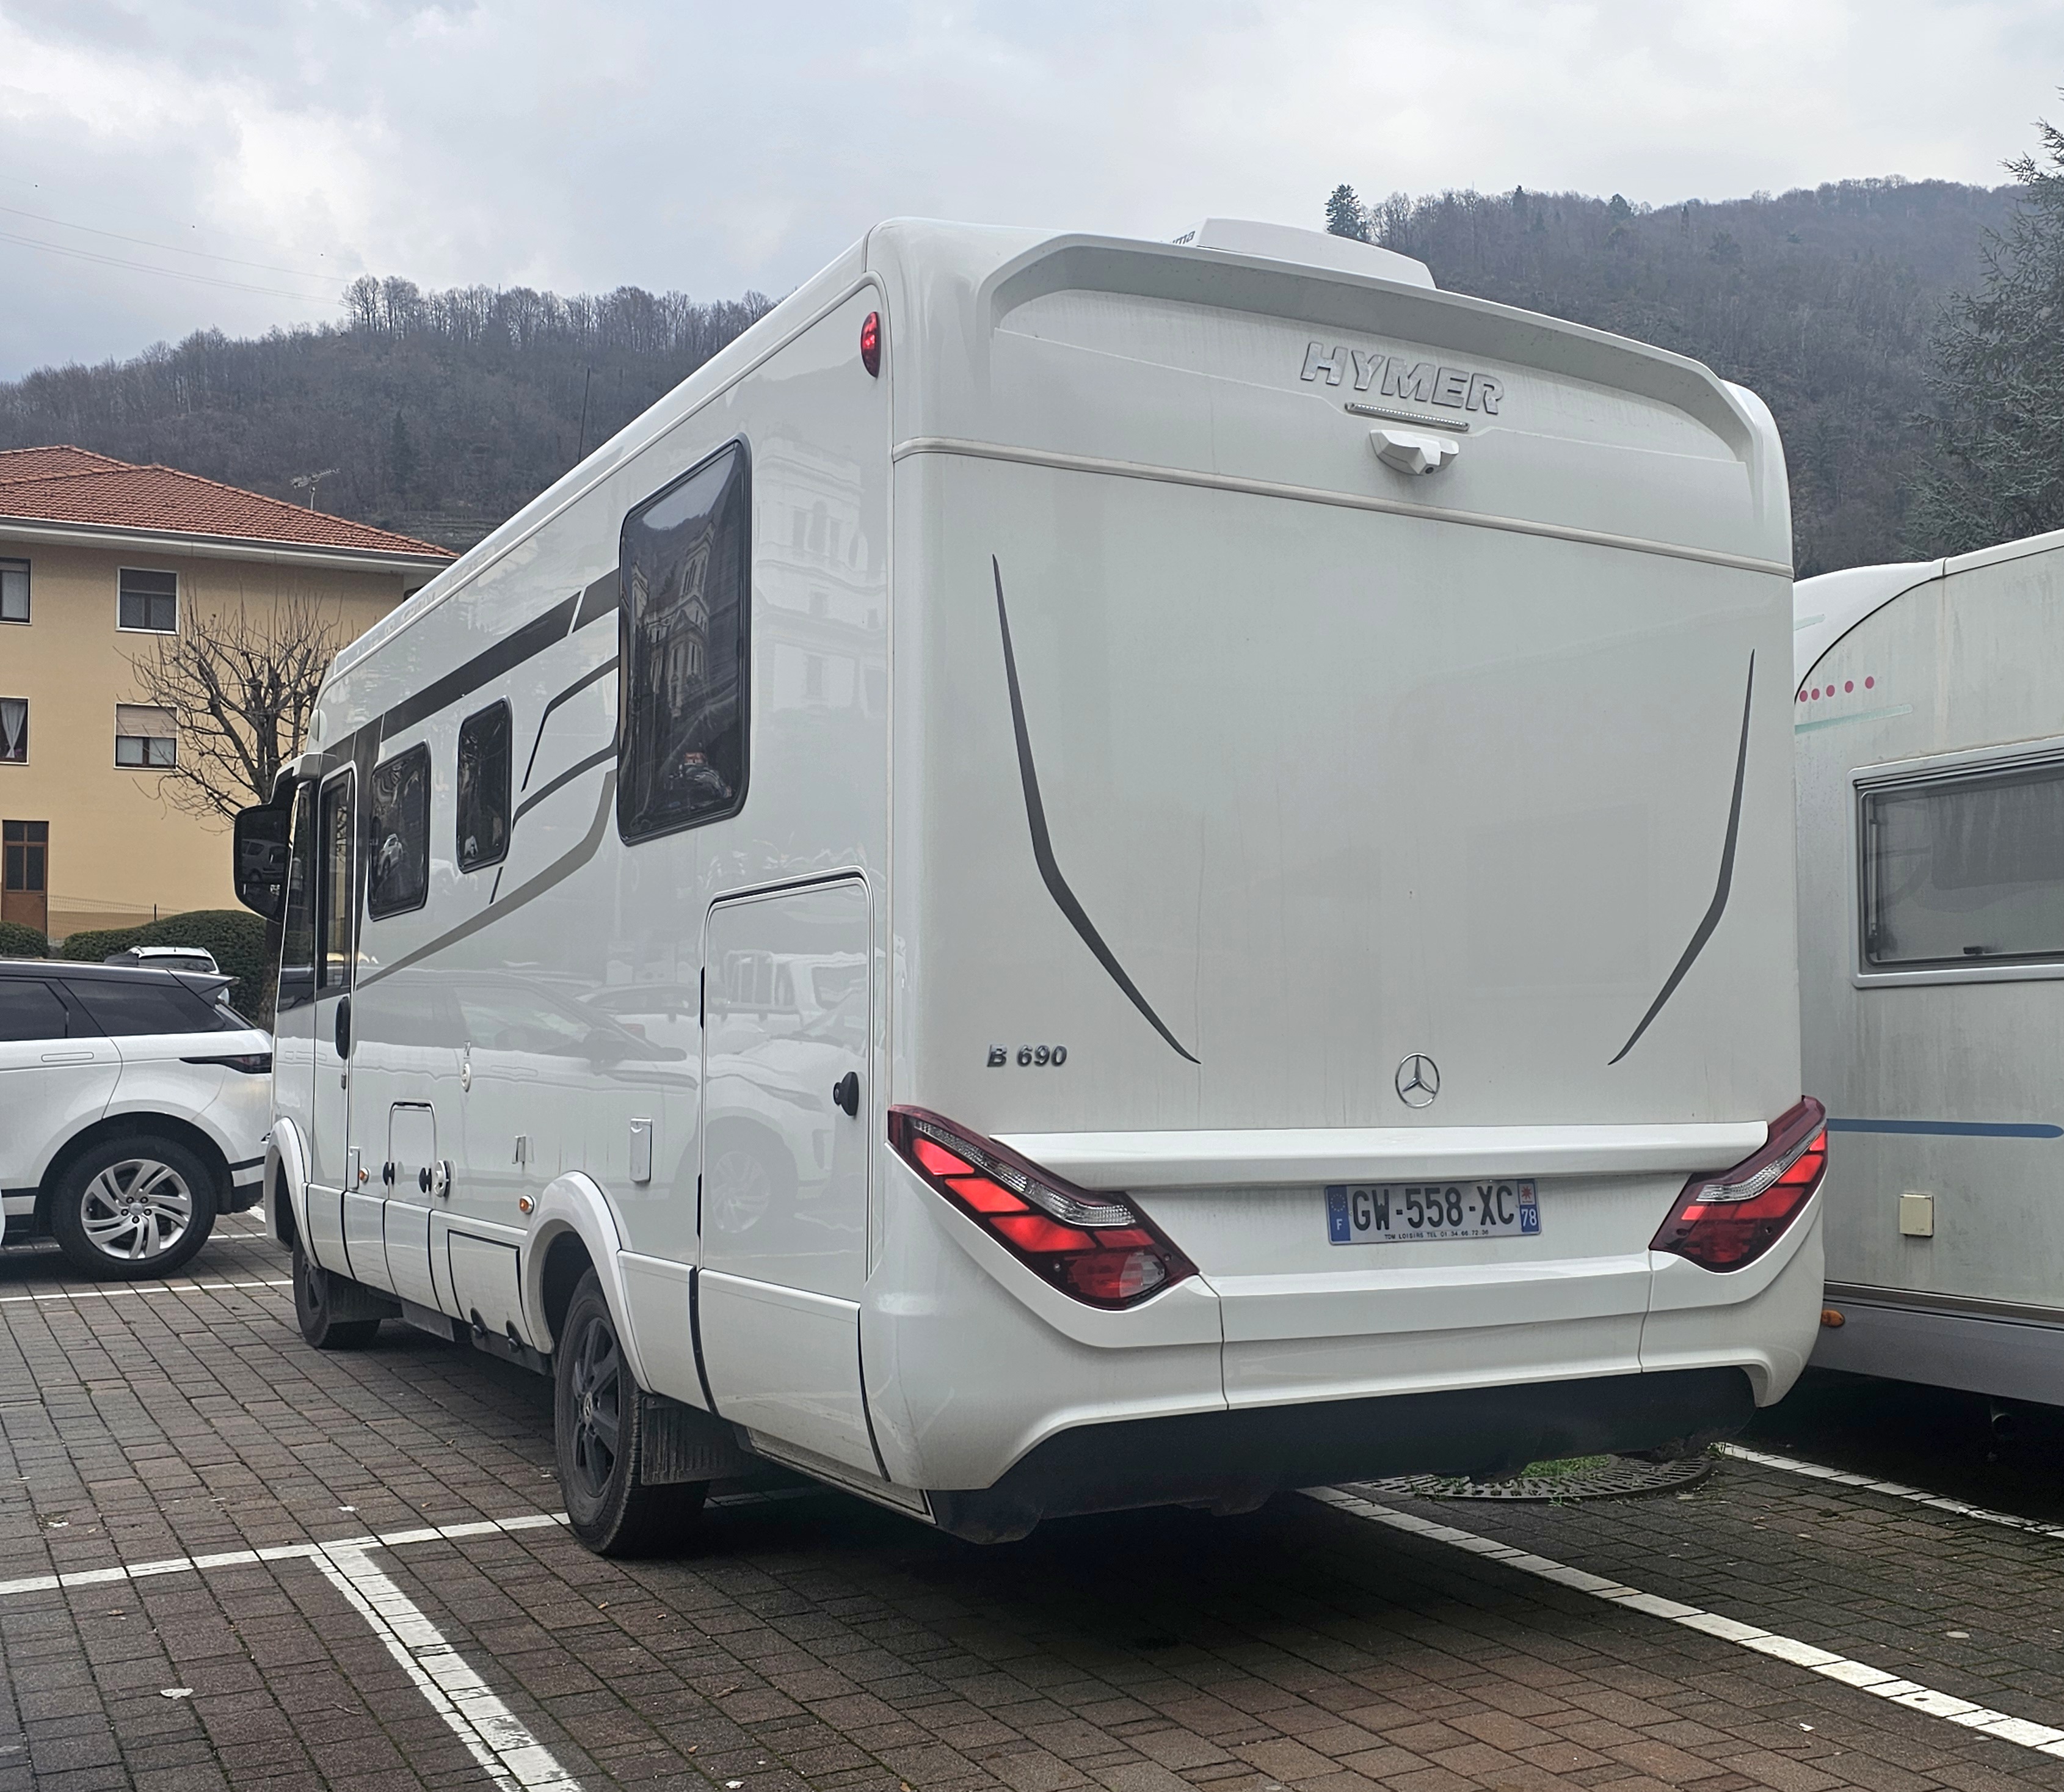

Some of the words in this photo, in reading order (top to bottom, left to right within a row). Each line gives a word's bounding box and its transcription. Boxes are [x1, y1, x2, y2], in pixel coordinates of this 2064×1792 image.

[1300, 341, 1503, 414] HYMER
[986, 1044, 1007, 1067] B
[1016, 1044, 1067, 1067] 690
[1353, 1186, 1514, 1231] GW-558-XC
[1521, 1208, 1538, 1227] 78
[1336, 1218, 1343, 1231] F
